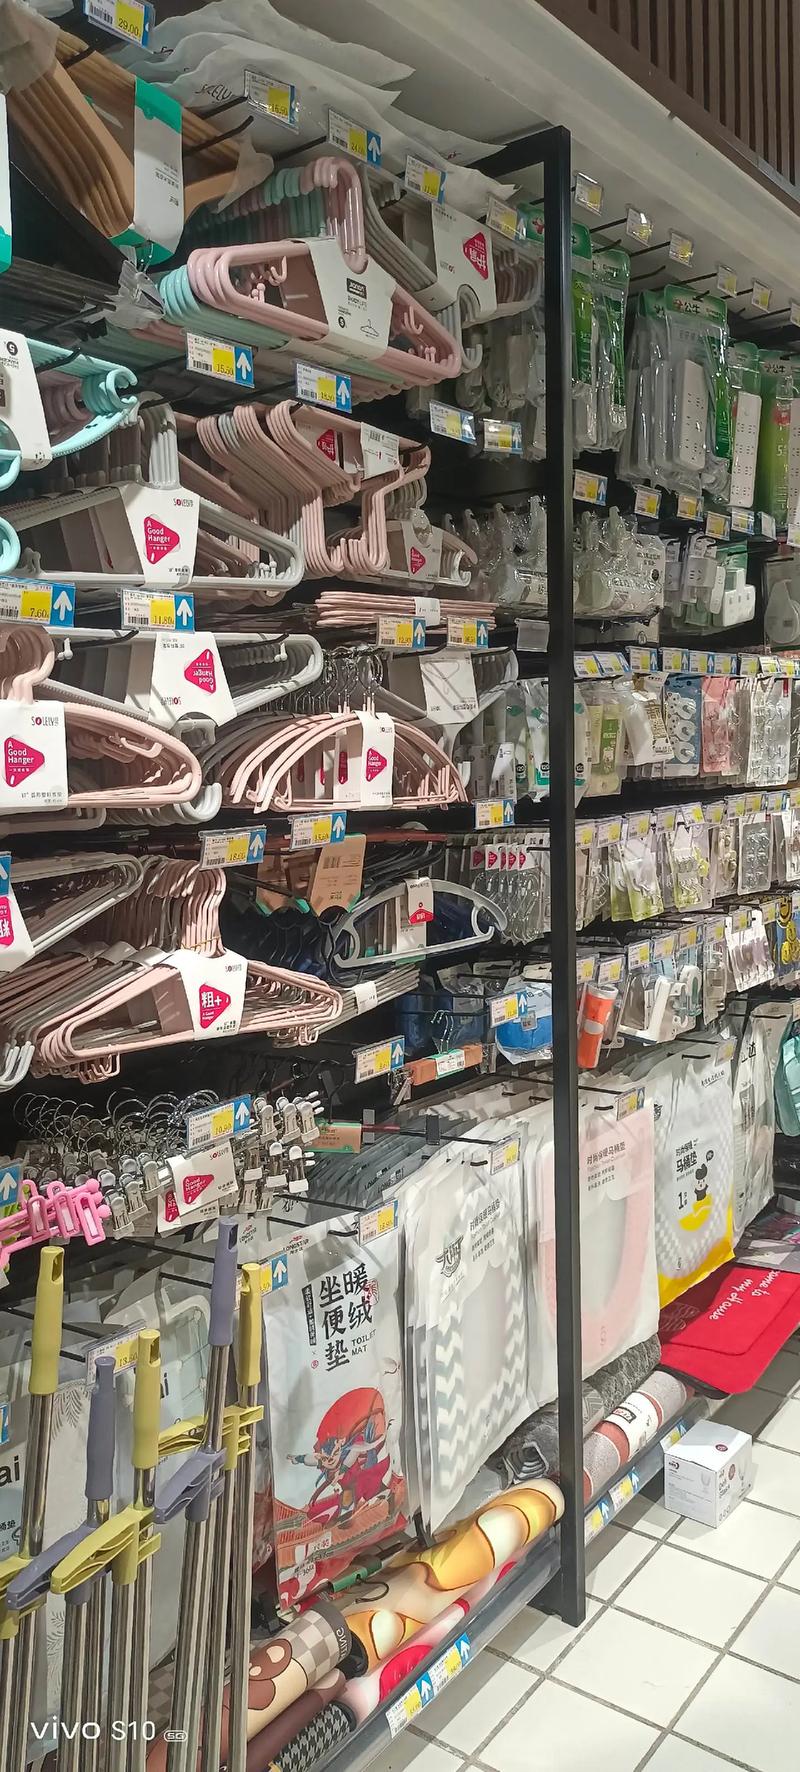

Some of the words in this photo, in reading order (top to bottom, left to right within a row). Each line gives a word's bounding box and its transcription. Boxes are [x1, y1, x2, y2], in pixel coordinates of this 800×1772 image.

[147, 527, 164, 535] Good
[147, 534, 171, 544] Hanger
[8, 740, 13, 748] A
[8, 748, 27, 756] Good
[8, 757, 34, 766] Hanger
[676, 1151, 697, 1173] 马桶垫
[731, 1278, 753, 1292] my
[709, 1292, 744, 1320] House
[319, 1275, 351, 1372] 坐便垫
[351, 1328, 377, 1346] TOILET
[351, 1345, 368, 1356] MAT
